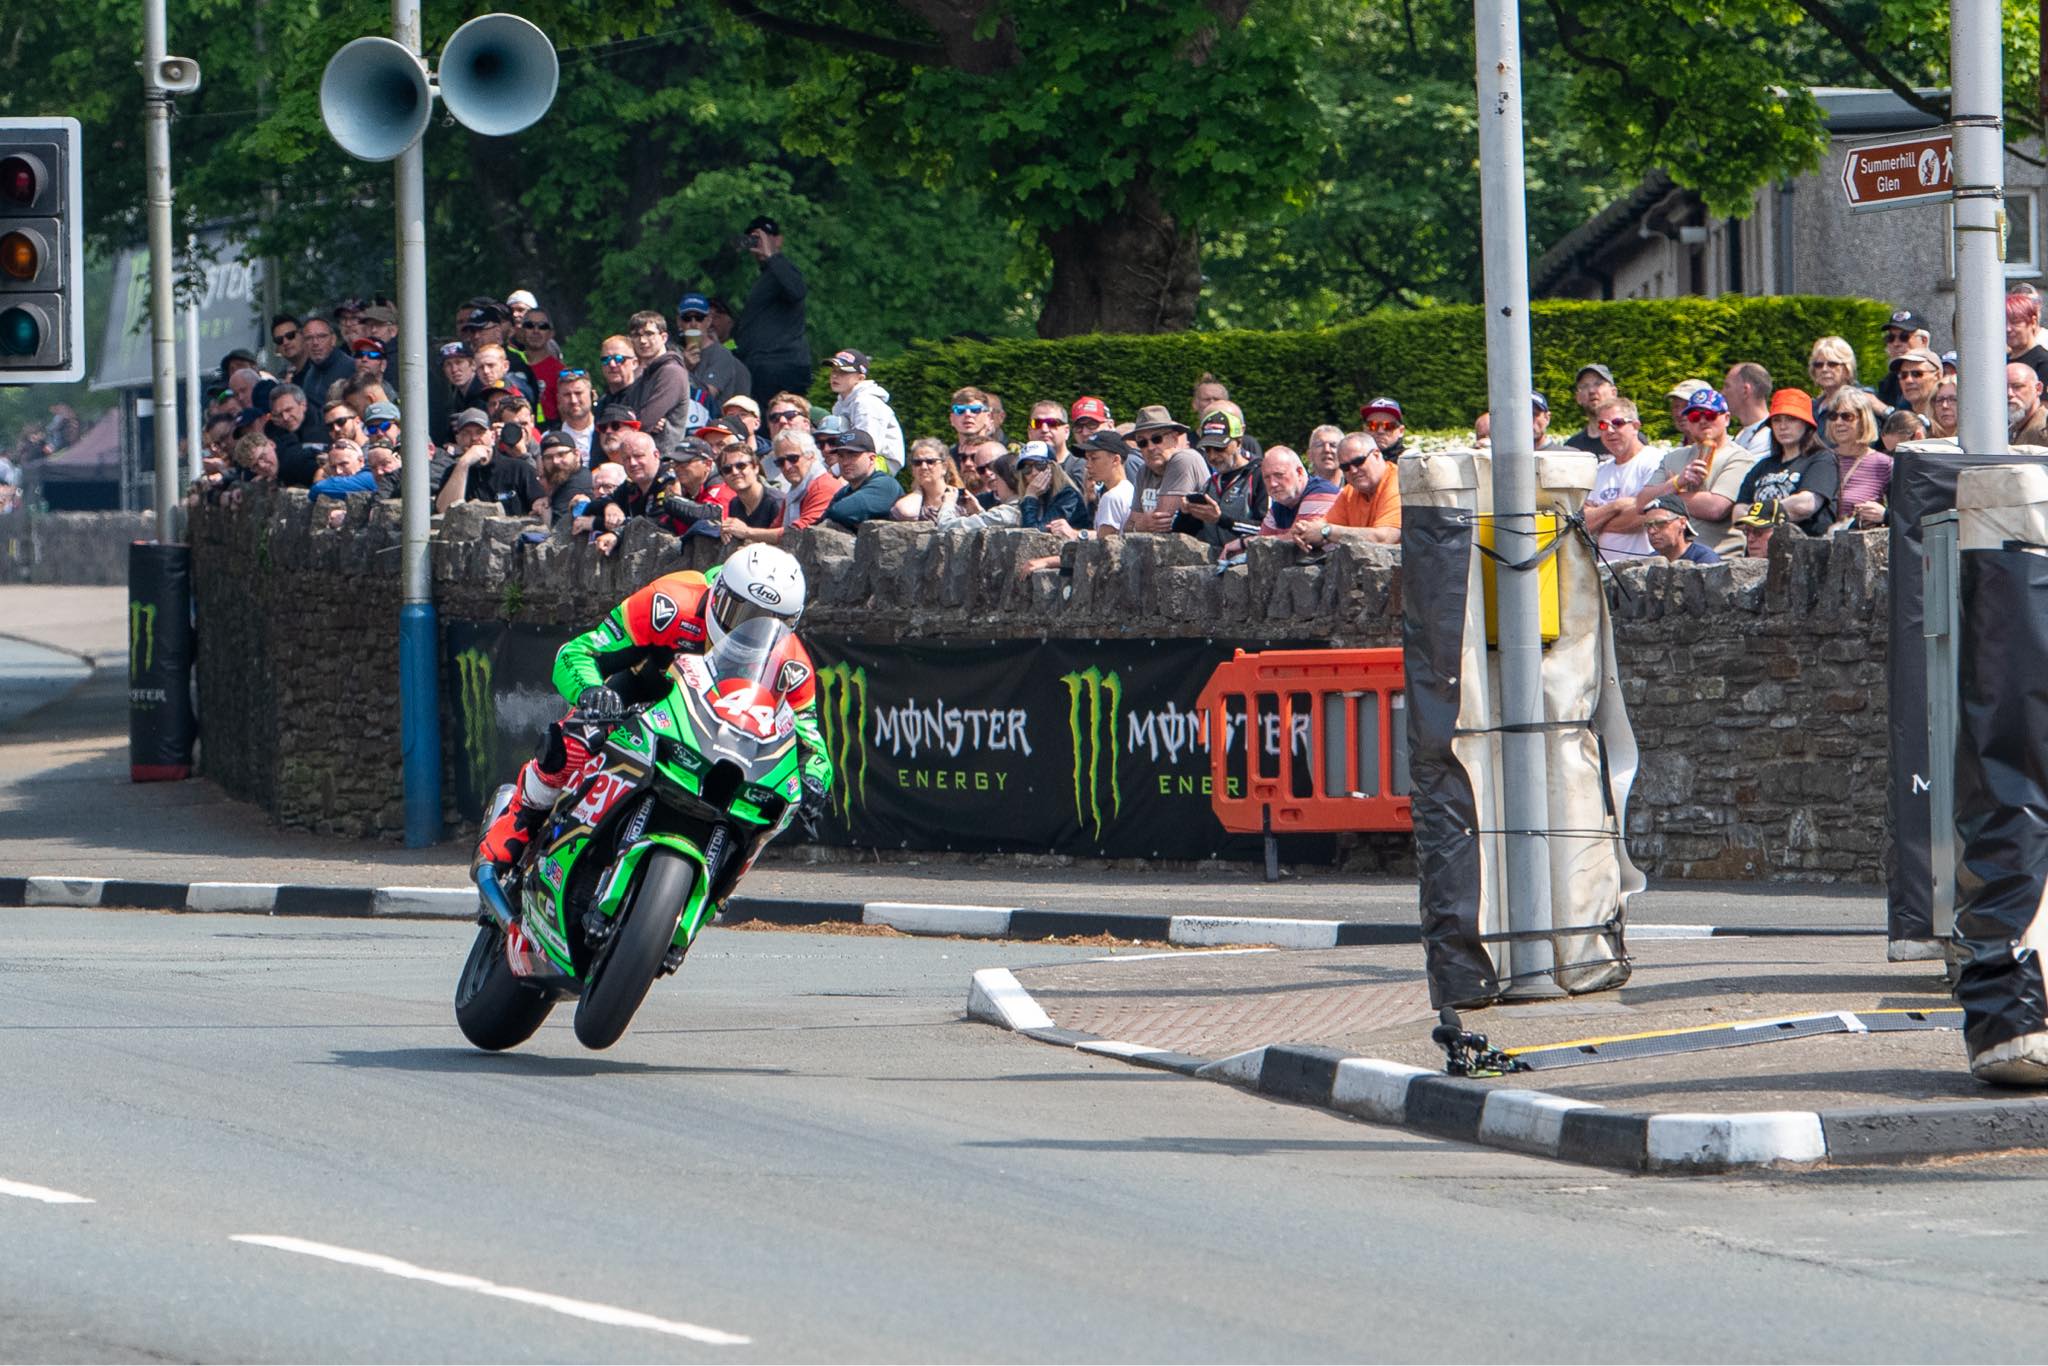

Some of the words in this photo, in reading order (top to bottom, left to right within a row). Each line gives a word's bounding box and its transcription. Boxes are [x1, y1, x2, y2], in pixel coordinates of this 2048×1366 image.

[1861, 151, 1916, 174] Summerhill
[1877, 176, 1900, 193] Glen
[753, 586, 777, 602] Arai
[129, 688, 167, 702] STER
[712, 688, 776, 736] 44
[874, 698, 1032, 760] MONSTER
[898, 768, 1009, 792] ENERGY
[1158, 775, 1239, 796] ENER
[705, 828, 726, 867] AXTON
